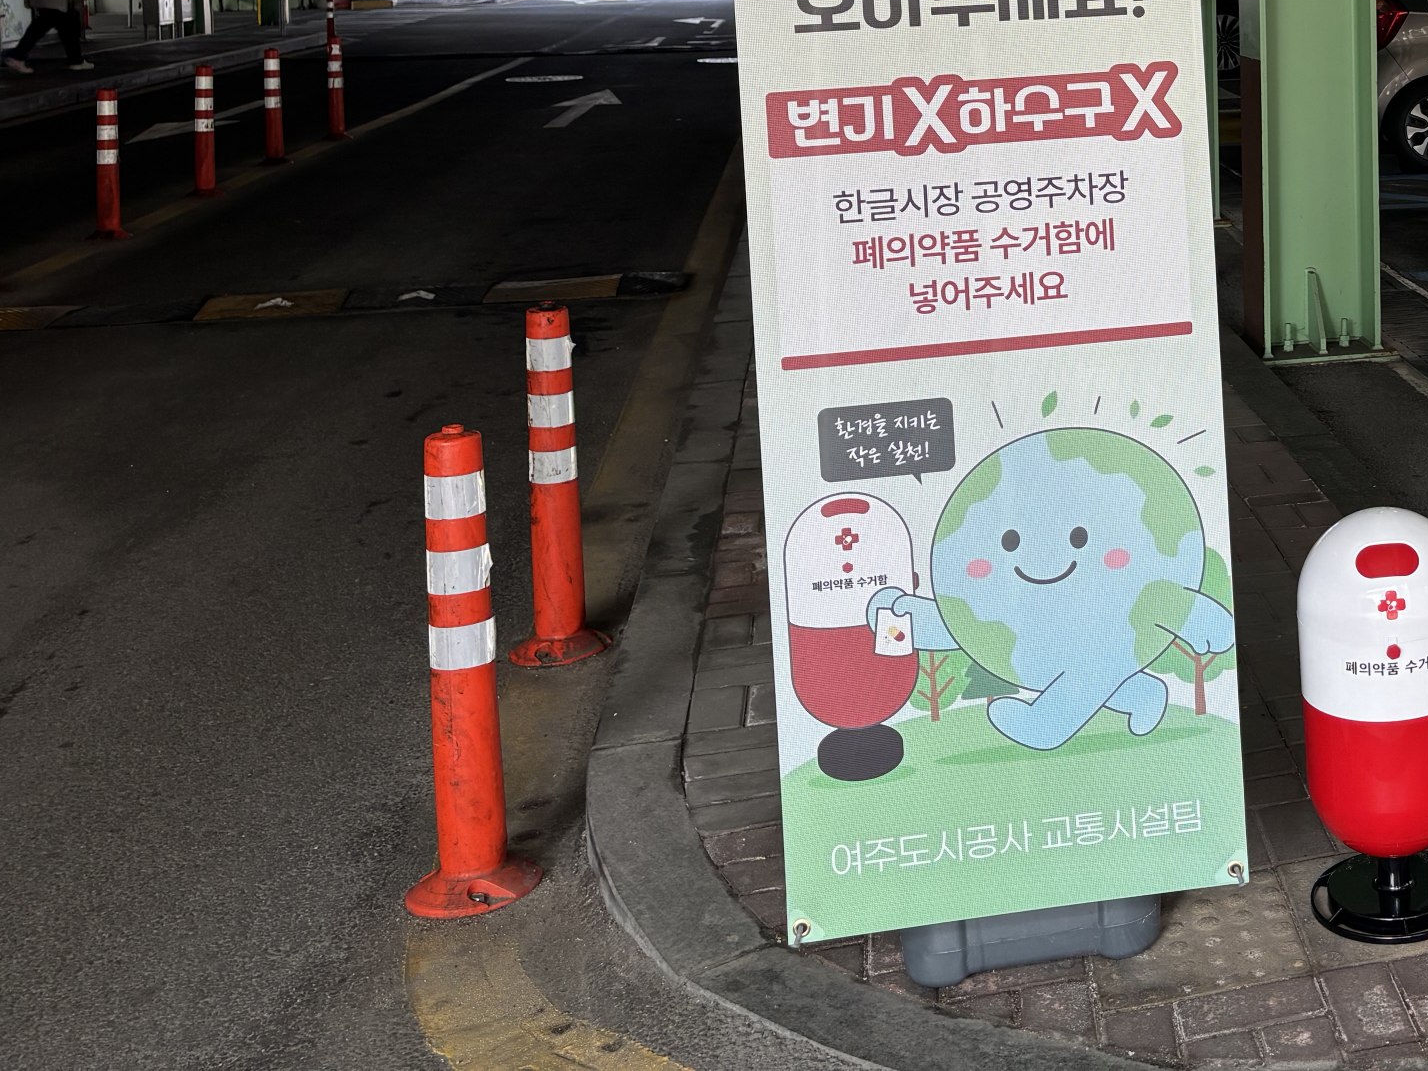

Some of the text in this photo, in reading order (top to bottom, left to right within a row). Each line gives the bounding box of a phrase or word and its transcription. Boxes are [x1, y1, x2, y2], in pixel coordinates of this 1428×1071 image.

[833, 170, 1129, 224] 한글시장 공영주차장
[852, 218, 1116, 269] 폐의약품 수거함에
[909, 271, 1068, 315] 넣어주세요
[835, 410, 940, 439] 환경을 지키는
[846, 441, 930, 467] 작은 실천!
[812, 574, 888, 592] 폐의약품 수거함
[1345, 661, 1400, 676] 폐의약품
[831, 799, 1203, 877] 여주도시공사 교통시설팀
